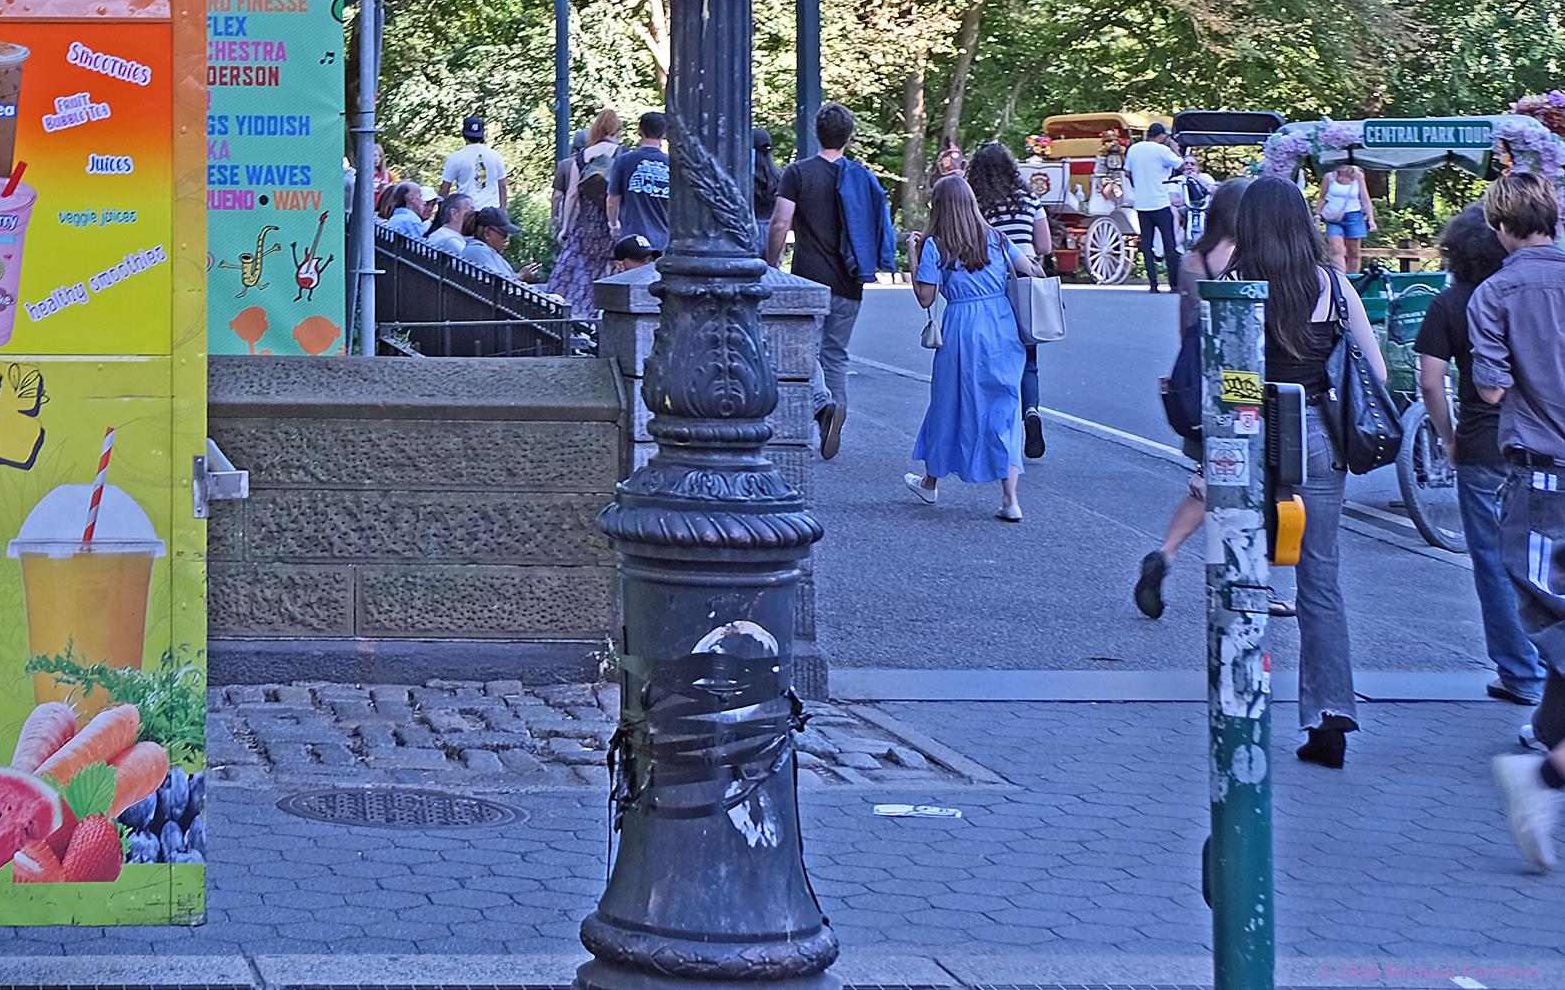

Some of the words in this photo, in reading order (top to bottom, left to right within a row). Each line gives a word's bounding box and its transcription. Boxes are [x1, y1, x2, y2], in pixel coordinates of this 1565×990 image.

[235, 115, 311, 136] YIDDISH
[1365, 126, 1420, 144] CENTRAL
[1422, 126, 1455, 143] PARK
[207, 164, 240, 186] ESE
[244, 164, 312, 186] WAVES
[272, 189, 323, 211] WAYV
[57, 208, 98, 228] veggie
[99, 208, 138, 227] juices
[25, 282, 90, 321] healthy
[89, 245, 167, 292] smoothies
